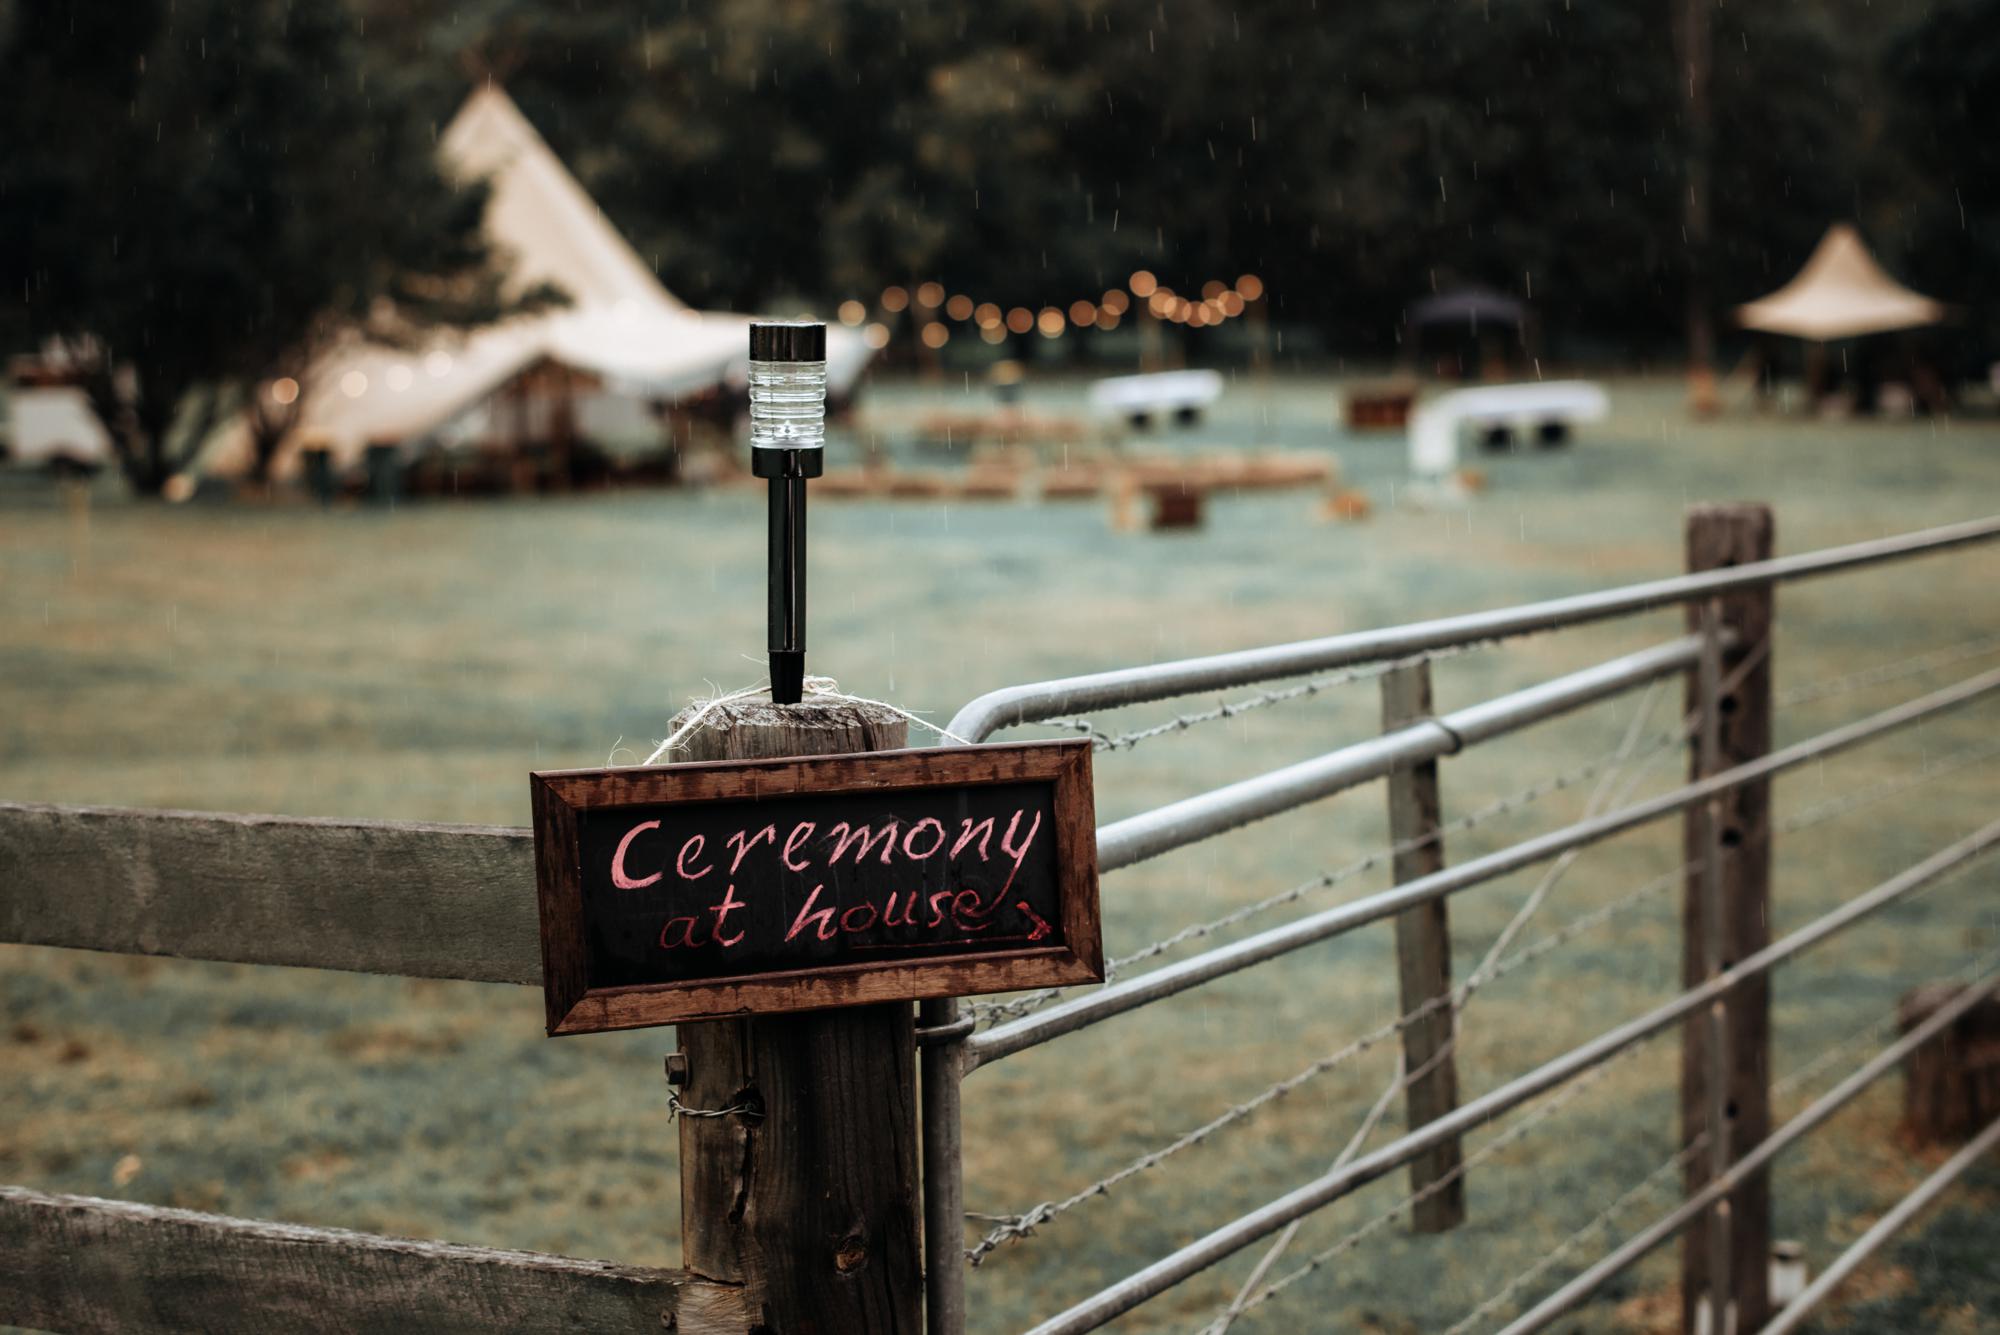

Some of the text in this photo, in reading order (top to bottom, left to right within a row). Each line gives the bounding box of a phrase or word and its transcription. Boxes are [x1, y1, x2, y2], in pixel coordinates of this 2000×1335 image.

[610, 809, 1041, 915] Ceremony
[659, 884, 994, 949] at house
